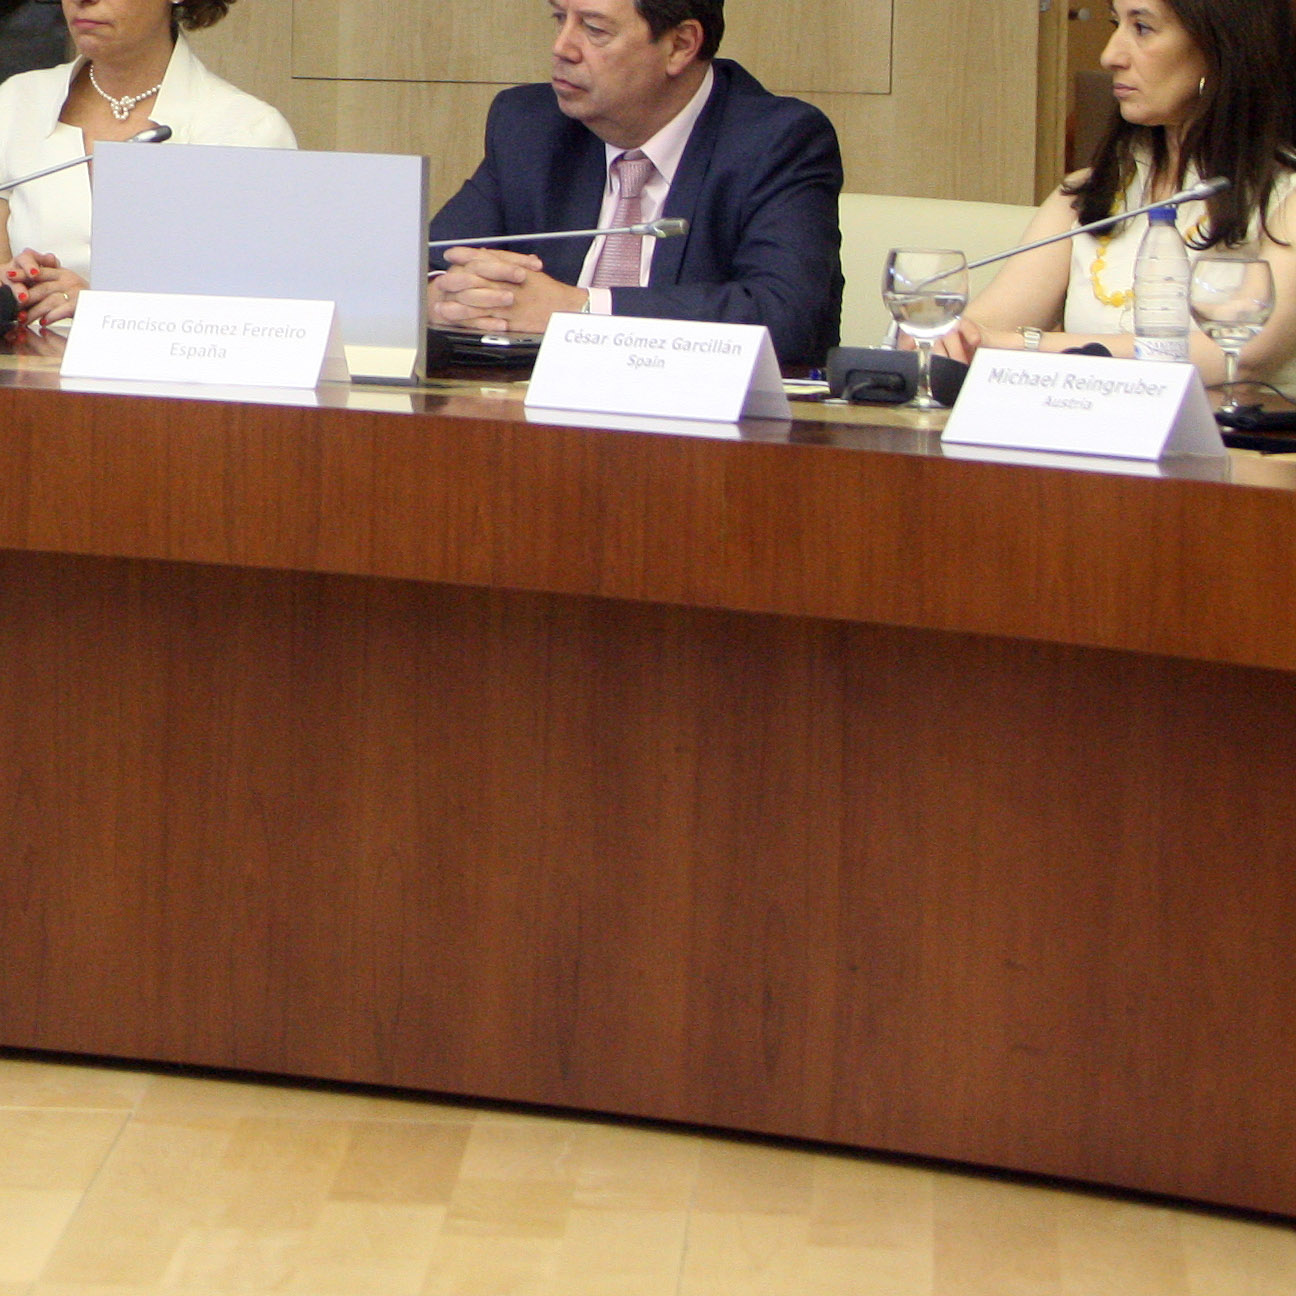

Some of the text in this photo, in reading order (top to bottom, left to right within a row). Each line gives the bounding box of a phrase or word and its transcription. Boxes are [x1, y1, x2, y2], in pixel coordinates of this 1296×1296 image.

[102, 315, 306, 339] Francisco Gómez Ferreiro
[170, 343, 227, 359] España
[564, 329, 742, 355] César Gómez Garcillán
[627, 354, 665, 369] Spain
[988, 368, 1167, 397] Michael Reingruber
[1042, 396, 1093, 410] Austria
